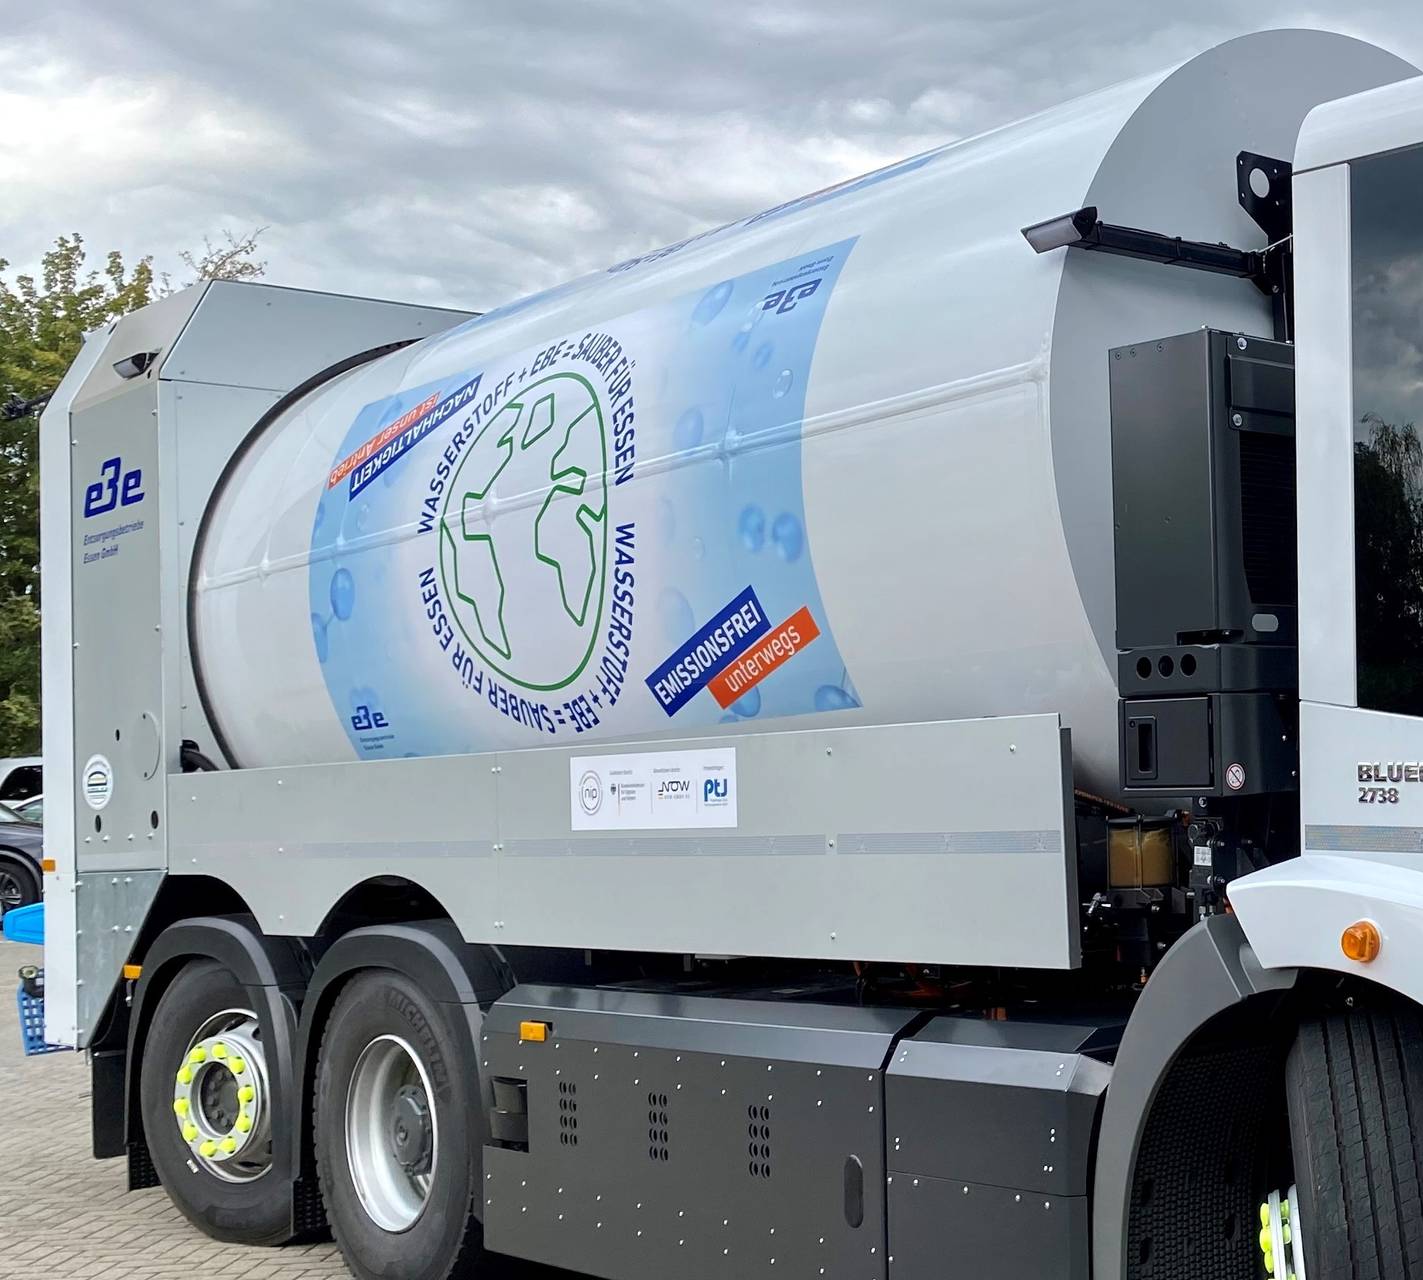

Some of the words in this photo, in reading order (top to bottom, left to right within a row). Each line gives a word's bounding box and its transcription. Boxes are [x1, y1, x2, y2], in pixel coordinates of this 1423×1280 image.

[529, 340, 568, 377] EBE
[571, 332, 623, 376] SAUBER
[421, 394, 439, 414] ist
[605, 356, 637, 409] FÜR
[351, 381, 478, 493] NACHHALTIGKEIT
[377, 409, 417, 446] unser
[417, 371, 515, 535] WASSERSTOFF
[612, 396, 636, 487] ESSEN
[330, 438, 377, 485] Antrieb
[418, 567, 455, 651] ESSEN
[596, 522, 636, 706] WASSERSTOFF
[451, 642, 484, 695] FÜR
[654, 600, 762, 706] EMISSIONSFREI
[724, 625, 801, 693] unterwegs
[487, 678, 556, 734] SAUBER
[563, 694, 601, 733] EBE
[1358, 787, 1401, 804] 2738
